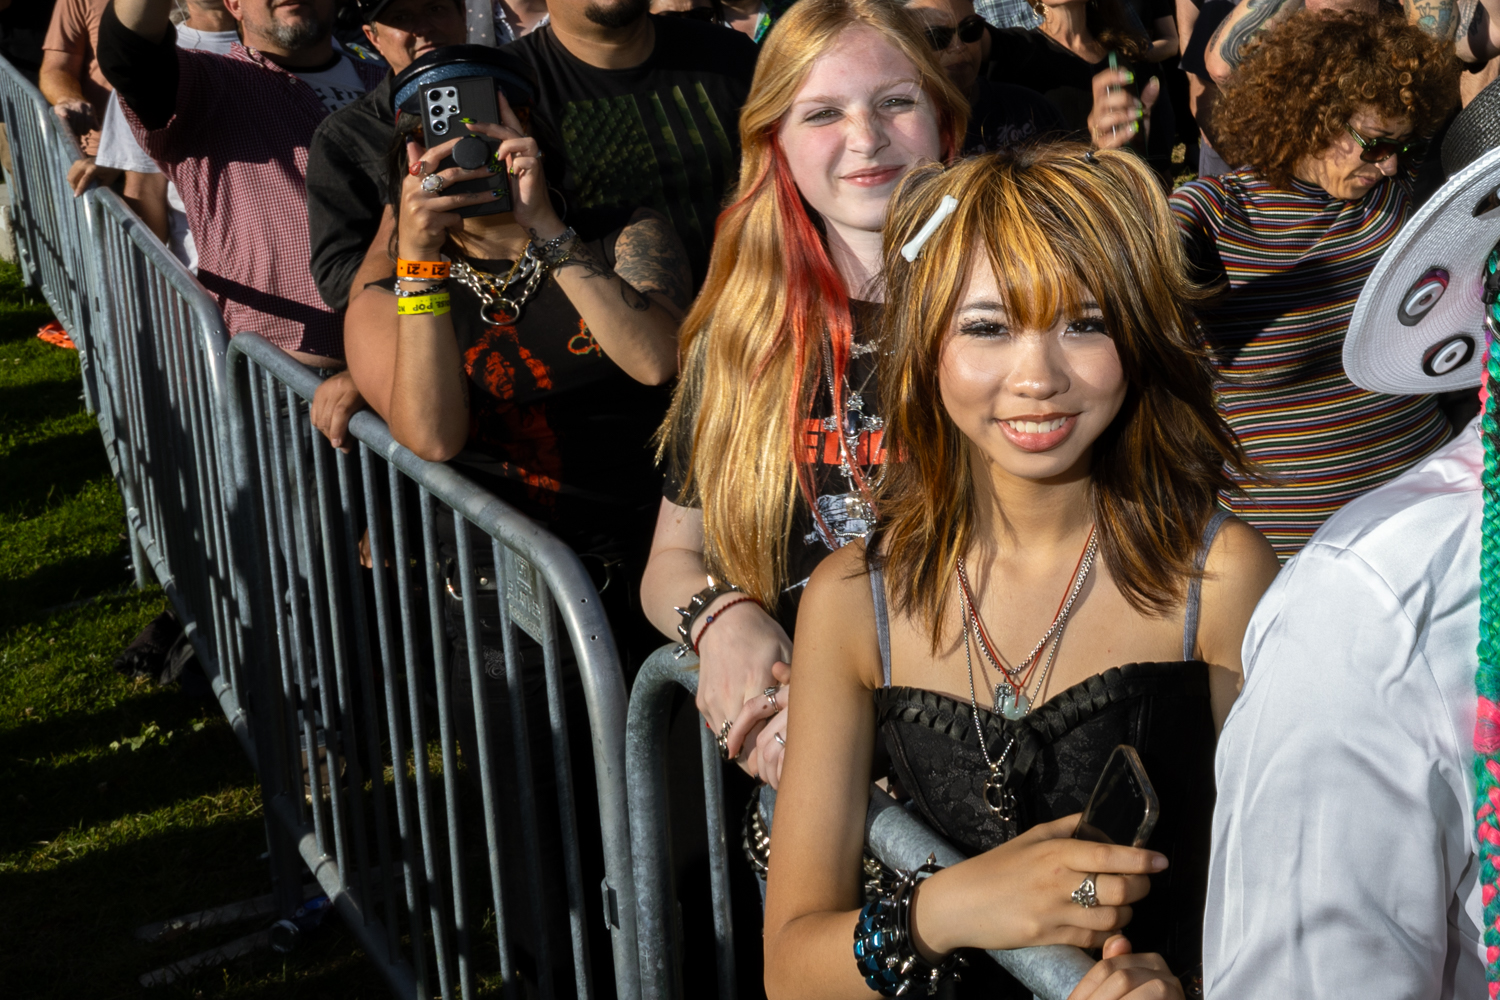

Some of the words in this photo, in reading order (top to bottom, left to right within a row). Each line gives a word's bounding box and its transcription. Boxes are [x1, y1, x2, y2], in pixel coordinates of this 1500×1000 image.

[407, 266, 420, 276] 21
[432, 266, 446, 276] 21
[412, 302, 434, 312] POP
